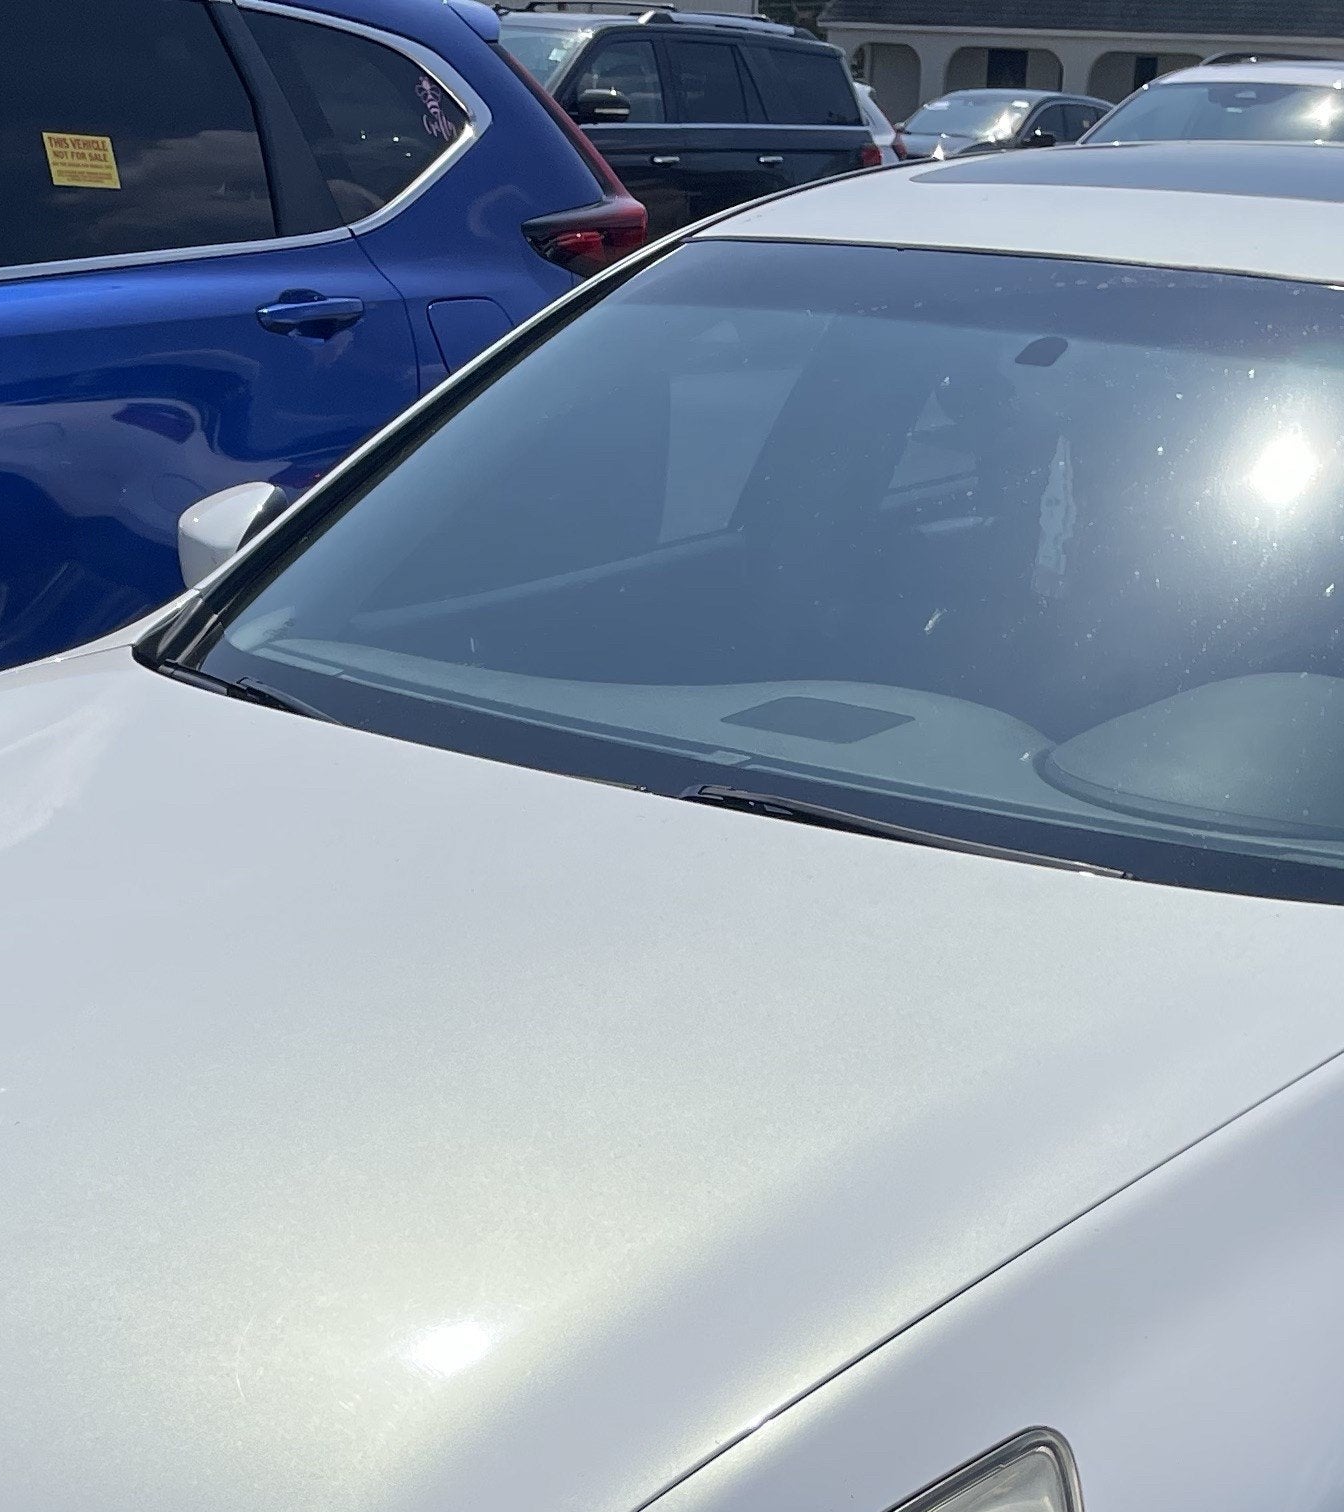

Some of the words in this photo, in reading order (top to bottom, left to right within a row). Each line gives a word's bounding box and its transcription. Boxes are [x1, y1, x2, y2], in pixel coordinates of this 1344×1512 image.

[47, 136, 69, 149] THIS
[69, 136, 110, 152] VEHICLE
[52, 150, 69, 160] NOT
[70, 151, 87, 161] FOR
[87, 152, 109, 163] SALE
